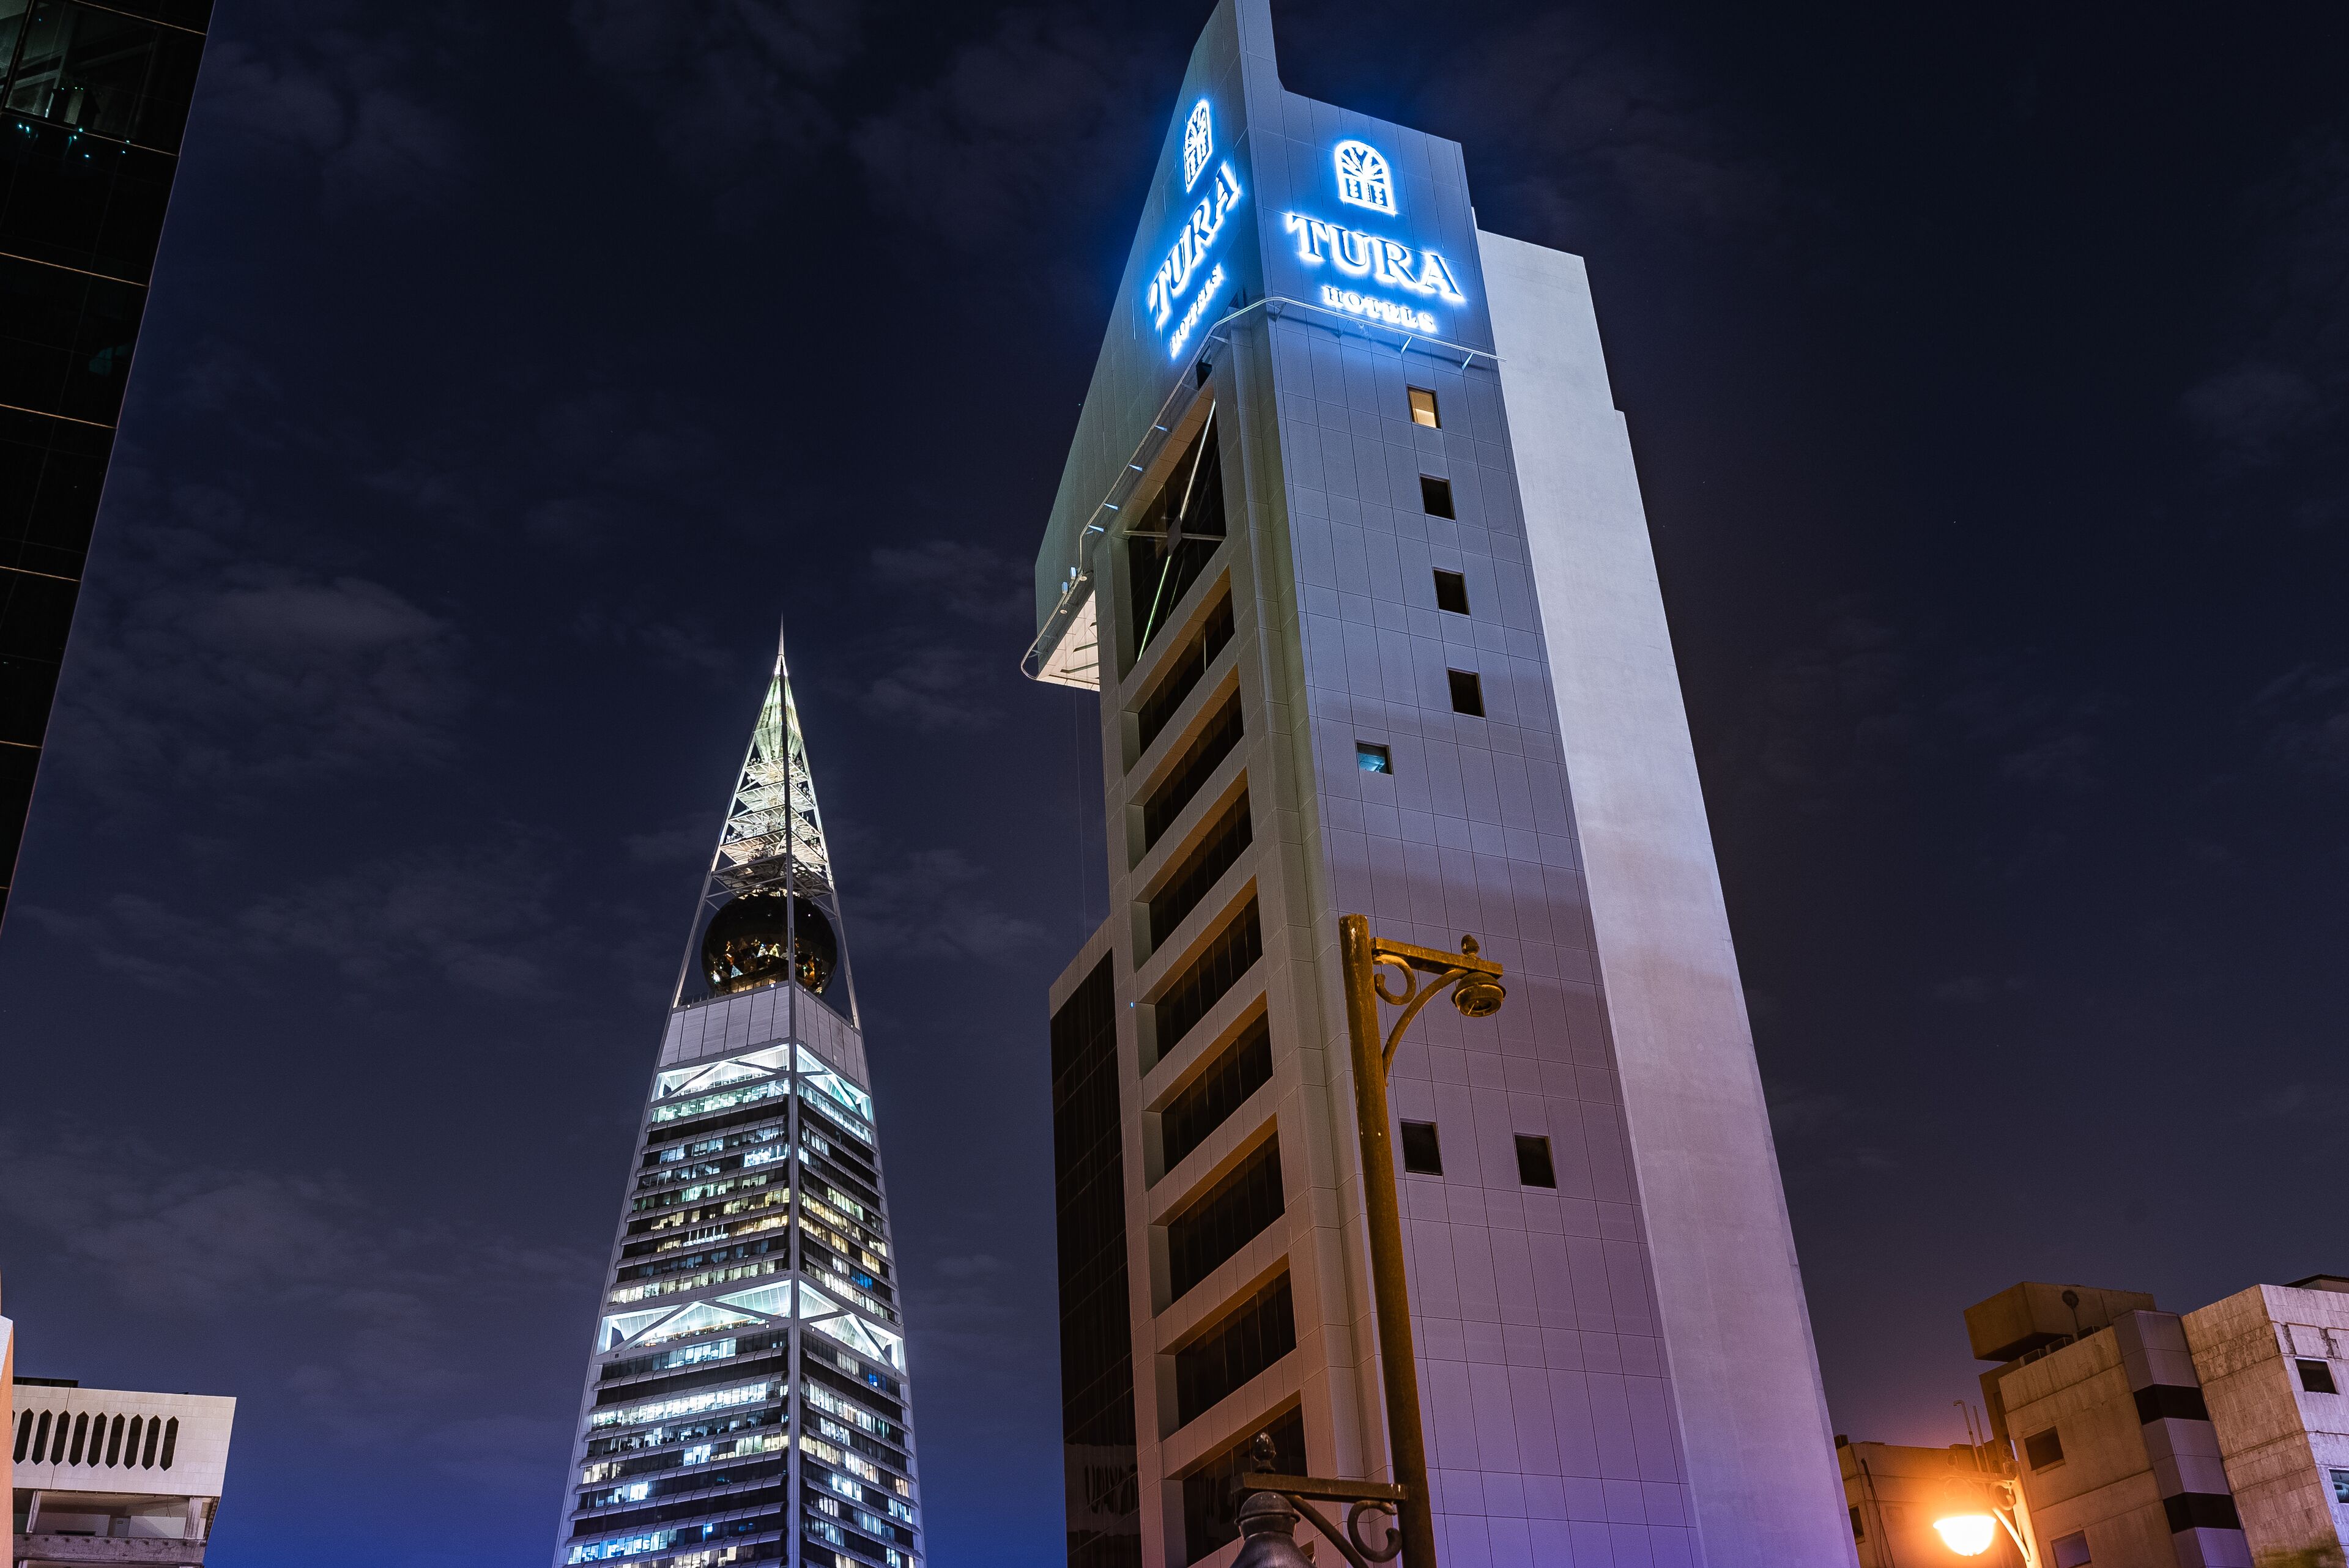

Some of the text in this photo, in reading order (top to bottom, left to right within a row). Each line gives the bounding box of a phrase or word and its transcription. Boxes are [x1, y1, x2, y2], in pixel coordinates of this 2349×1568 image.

[1148, 164, 1239, 329] TURA
[1285, 213, 1464, 301] TURA
[1323, 286, 1436, 332] HOTELS
